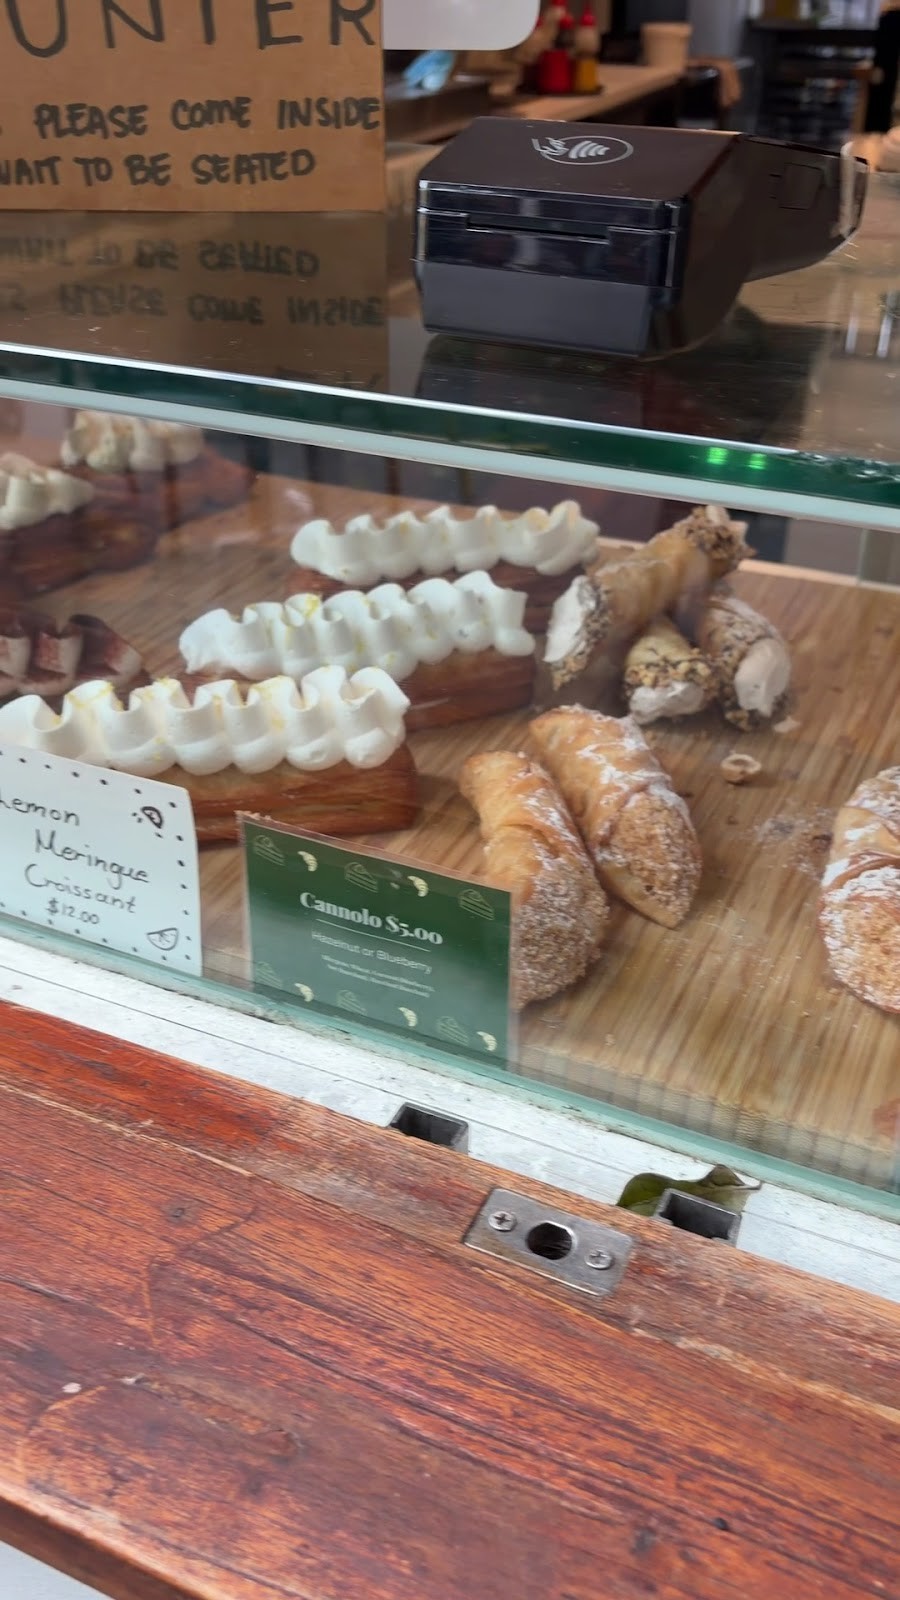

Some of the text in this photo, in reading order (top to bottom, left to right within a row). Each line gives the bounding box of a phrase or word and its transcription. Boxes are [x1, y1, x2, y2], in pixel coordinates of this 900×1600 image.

[34, 96, 381, 139] PLEASE COME INSIDE
[73, 156, 112, 187] TO
[123, 152, 172, 186] BE
[191, 148, 316, 185] SEATED
[35, 829, 149, 890] Meringue
[24, 863, 137, 914] Croissant
[45, 897, 100, 926] $12.00
[299, 891, 444, 946] Cannolo $5.00
[361, 947, 374, 958] or
